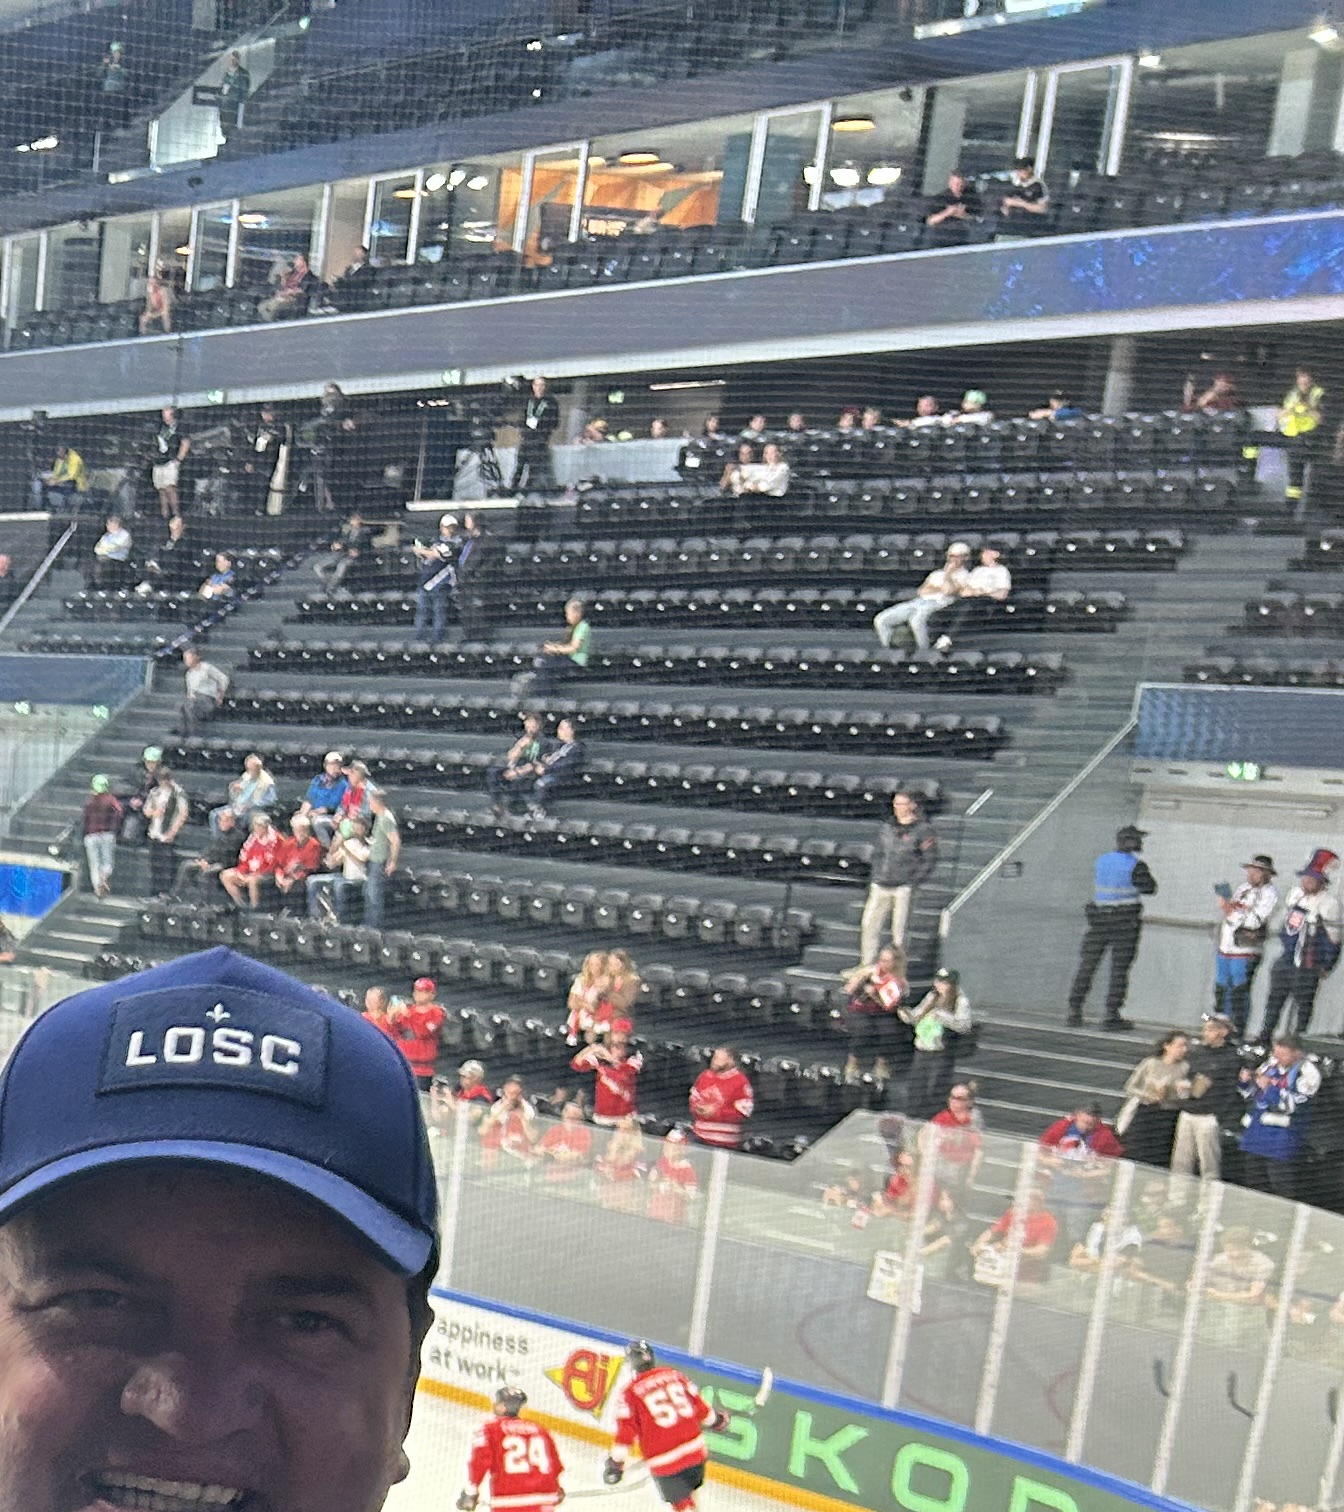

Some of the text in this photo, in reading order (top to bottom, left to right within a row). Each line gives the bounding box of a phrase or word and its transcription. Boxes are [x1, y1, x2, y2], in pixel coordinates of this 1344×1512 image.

[125, 1027, 301, 1076] LOSC
[437, 1316, 529, 1355] appiness
[457, 1357, 506, 1382] work
[643, 1382, 694, 1428] 55
[502, 1436, 550, 1474] 24
